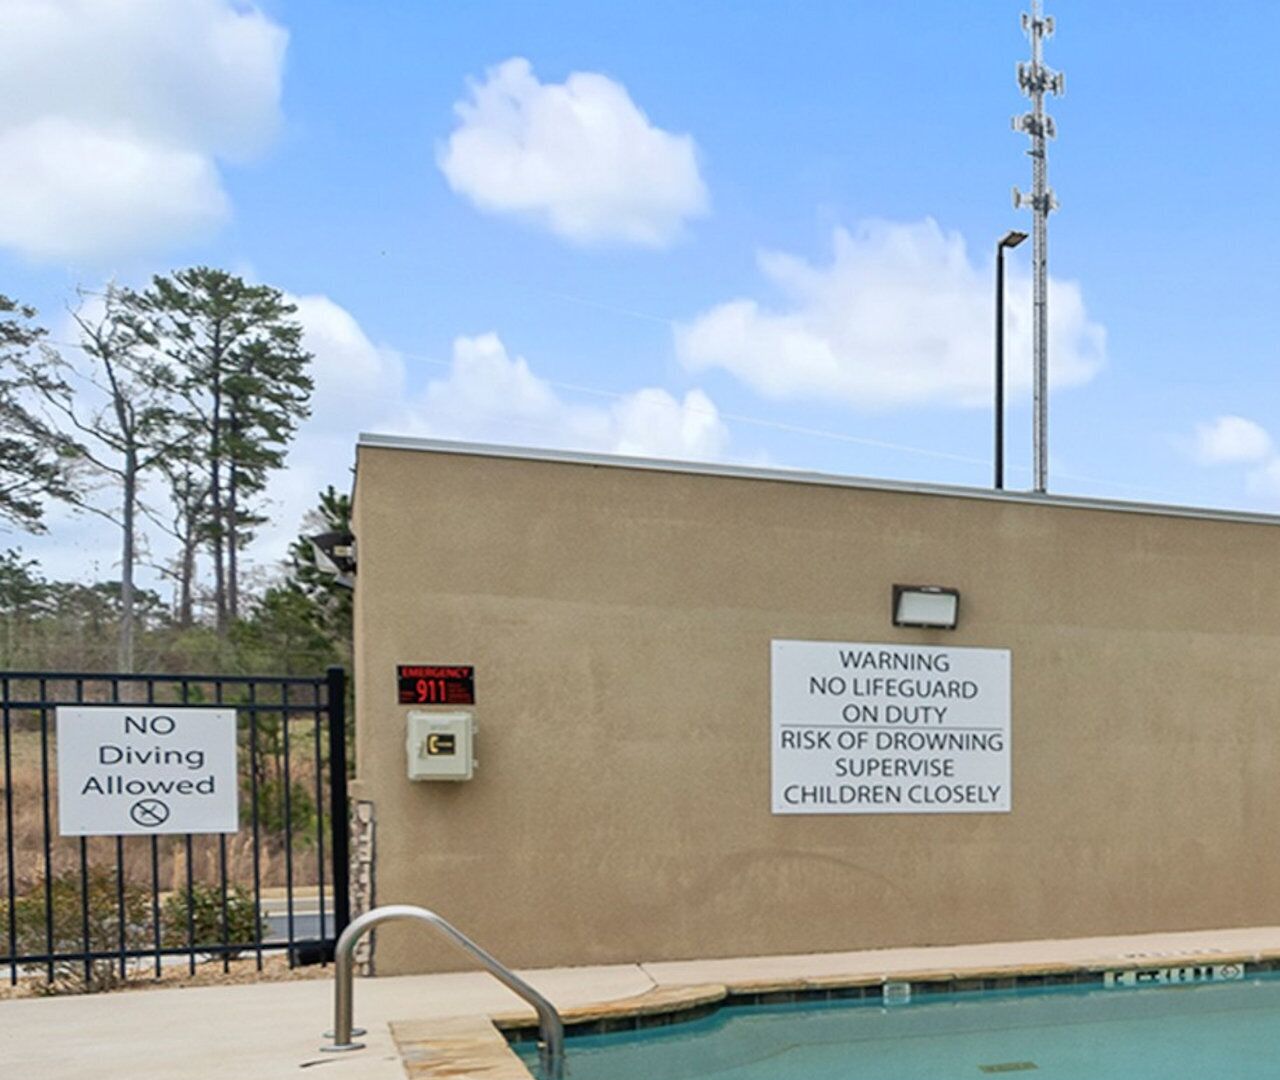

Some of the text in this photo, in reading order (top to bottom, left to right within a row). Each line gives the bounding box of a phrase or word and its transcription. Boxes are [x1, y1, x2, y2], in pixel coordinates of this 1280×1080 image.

[839, 650, 949, 672] WARNING
[401, 667, 470, 678] EMERGENCY
[415, 679, 447, 702] 911
[809, 677, 978, 699] NO LIFEGUARD
[843, 704, 948, 724] ON DUTY
[124, 715, 176, 735] NO
[781, 731, 1004, 751] RISK OF DROWNING
[99, 744, 206, 770] Diving
[835, 758, 954, 777] SUPERVISE
[82, 775, 215, 795] Allowed
[784, 785, 1001, 804] CHILDREN CLOSELY
